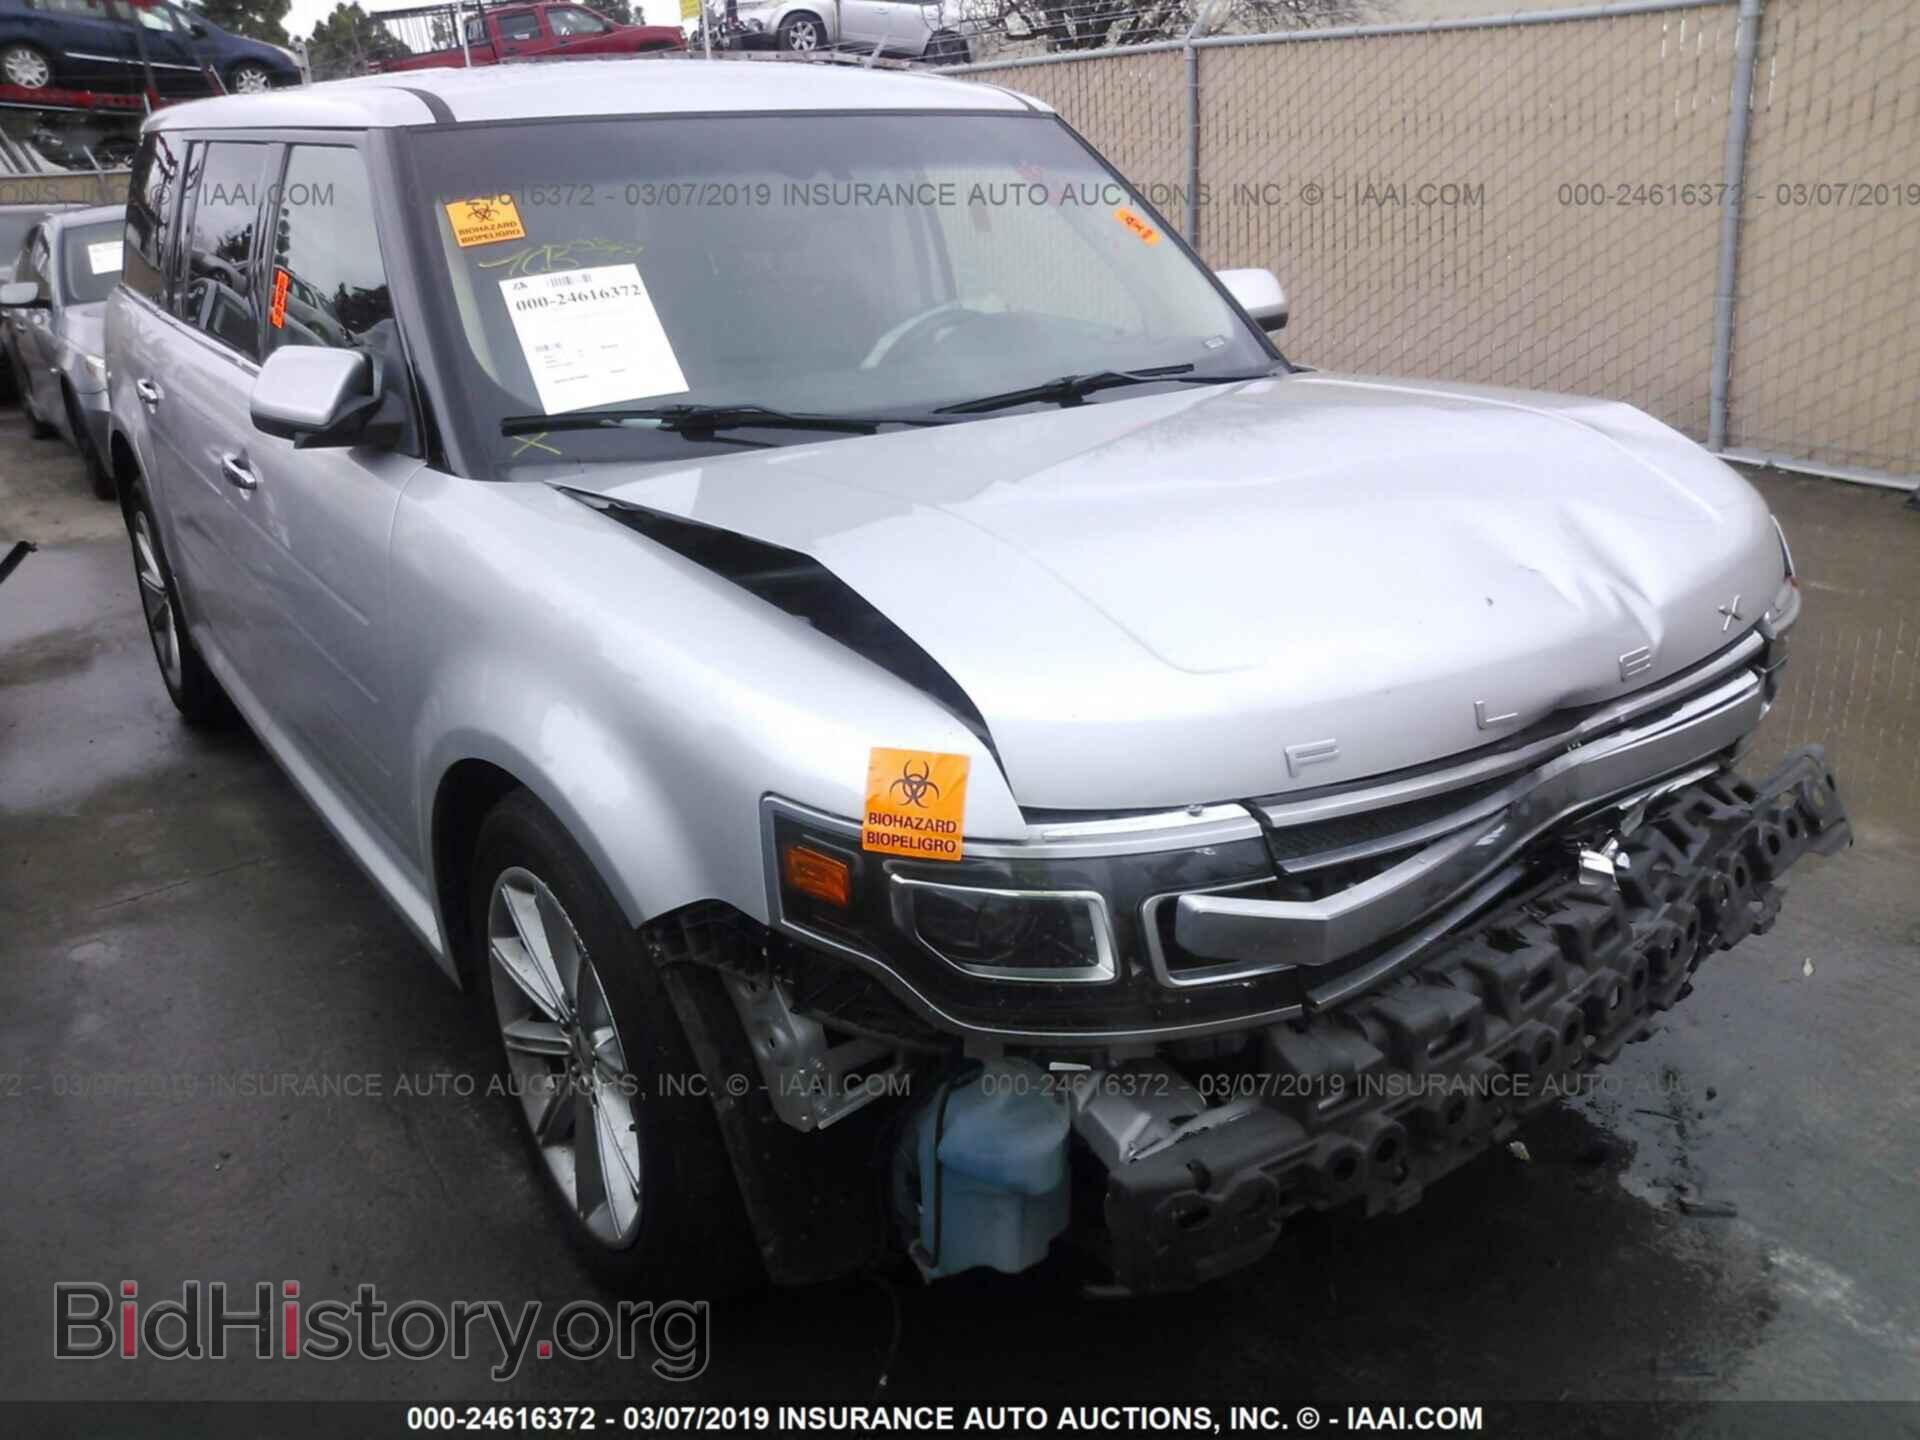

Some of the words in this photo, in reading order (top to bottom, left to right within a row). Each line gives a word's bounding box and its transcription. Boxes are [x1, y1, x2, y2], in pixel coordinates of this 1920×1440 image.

[515, 283, 642, 312] 000-24616372
[1285, 594, 1743, 778] FLEX
[868, 811, 957, 834] BIOHAZARD
[866, 831, 957, 853] BIOPELIGRO
